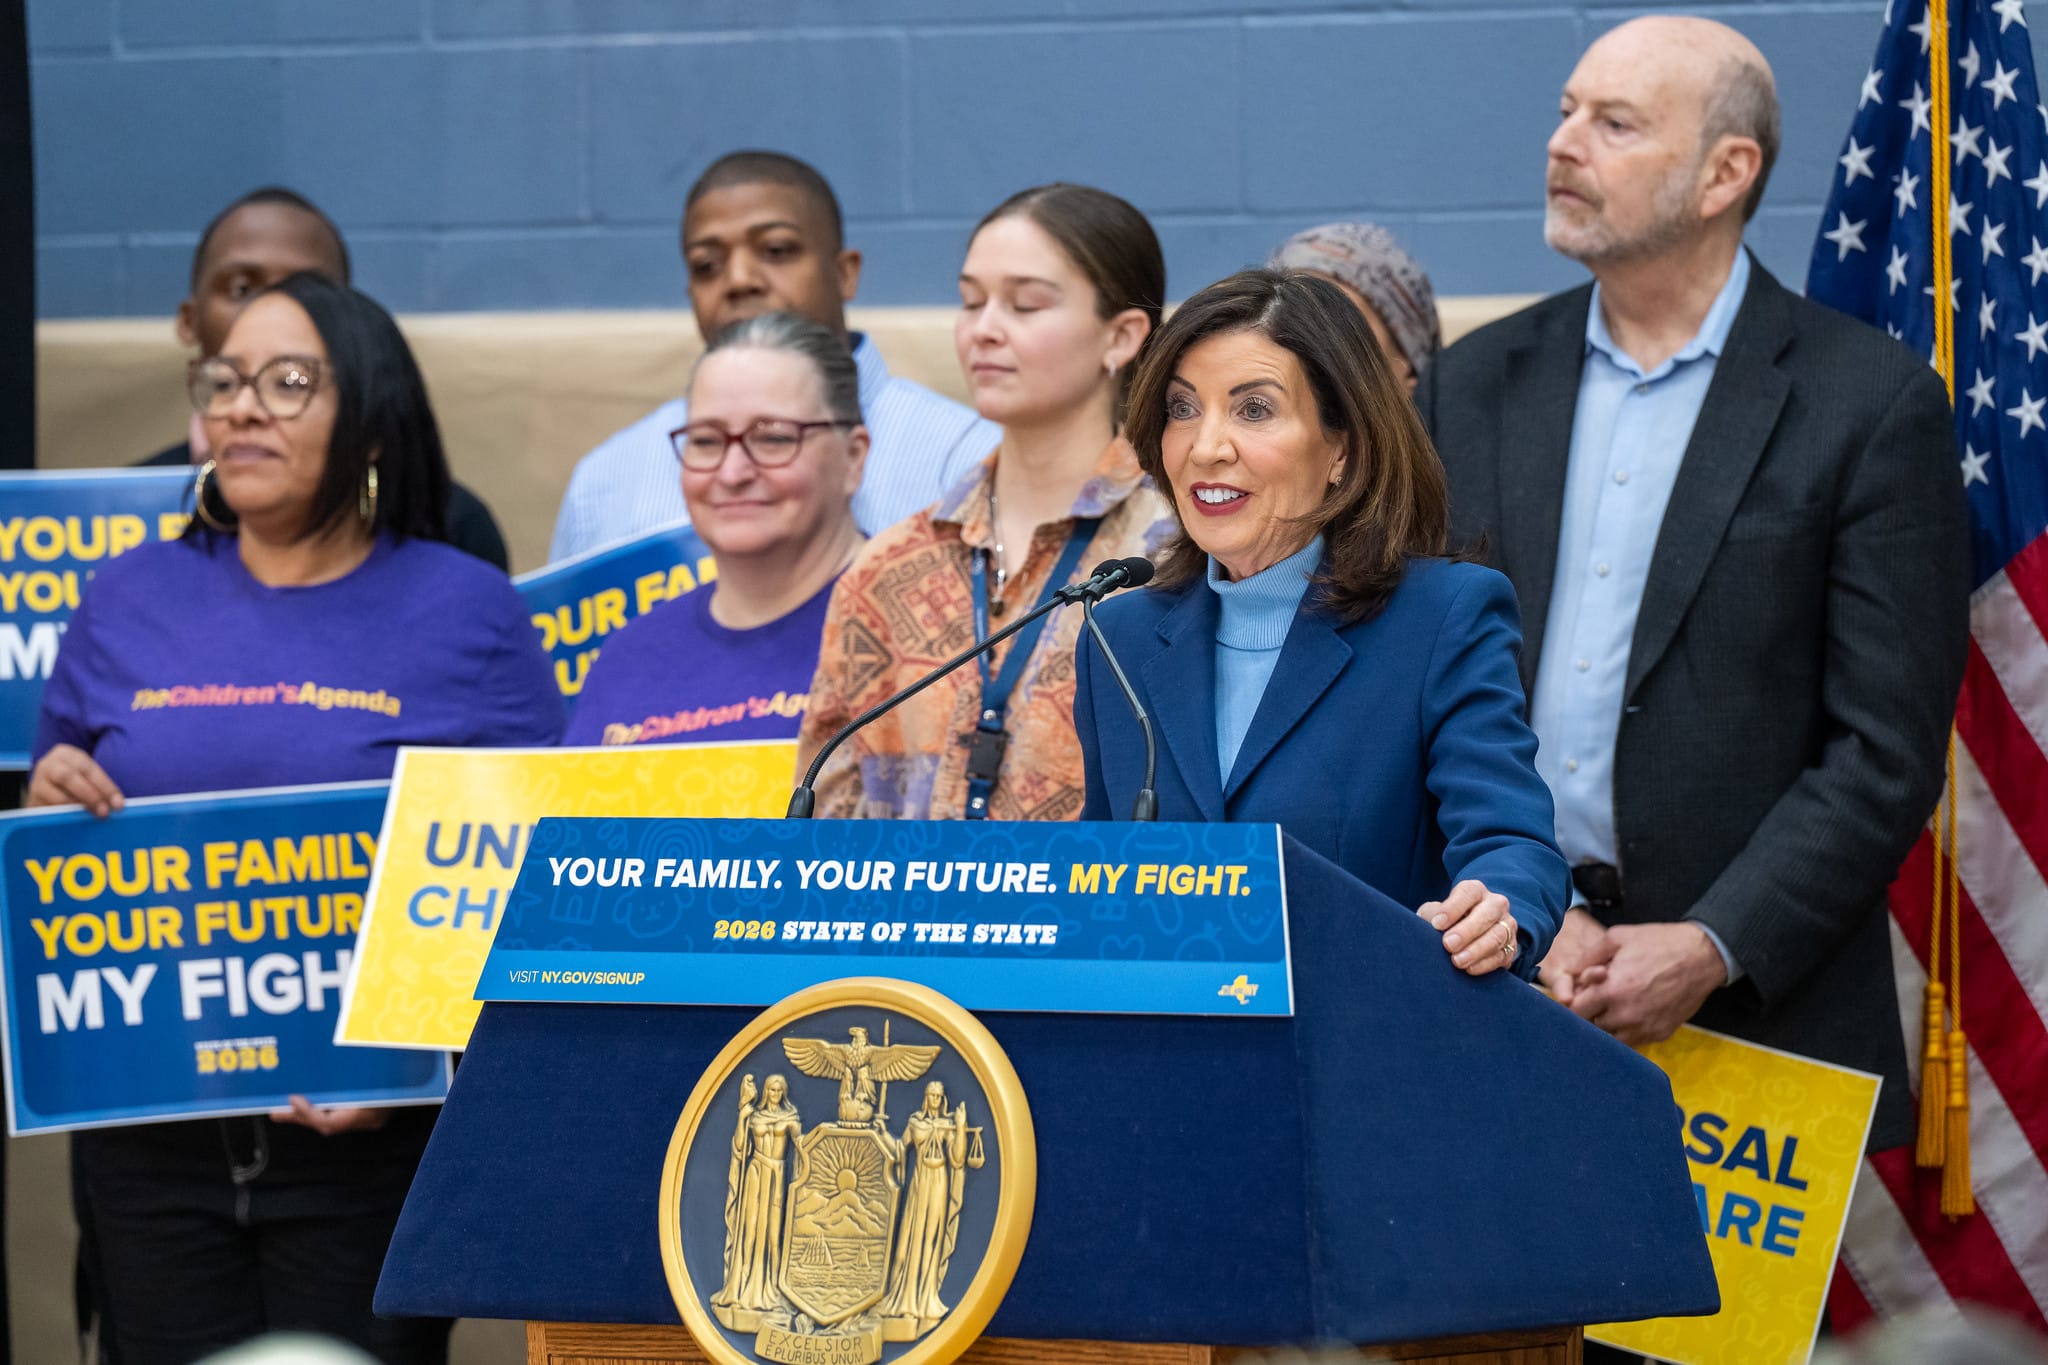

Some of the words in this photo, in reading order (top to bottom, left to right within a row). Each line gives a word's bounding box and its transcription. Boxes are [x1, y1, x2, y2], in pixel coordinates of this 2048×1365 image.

[425, 821, 538, 869] UN
[25, 846, 191, 904] YOUR
[548, 857, 646, 887] YOUR
[654, 858, 782, 889] FAMILY.
[795, 860, 896, 891] YOUR
[904, 861, 1057, 894] FUTURE.
[1068, 863, 1129, 894] MY
[1134, 864, 1251, 897] FIGHT.
[31, 907, 183, 960] YOUR
[195, 892, 369, 945] FUTUR
[407, 885, 513, 931] CH
[713, 919, 776, 941] 2026
[781, 920, 866, 942] STATE
[871, 921, 907, 943] OF
[913, 922, 968, 944] THE
[972, 923, 1058, 946] STATE
[36, 963, 158, 1035] MY
[178, 950, 355, 1022] FIGH
[509, 970, 540, 984] VISIT
[541, 971, 645, 986] NY.GOV/SIGNUP
[196, 1045, 279, 1074] 2026
[1676, 1104, 1809, 1192] SAL
[764, 1344, 772, 1357] E
[774, 1347, 827, 1364] PLURIBUS
[830, 1352, 864, 1363] UNUM
[769, 1329, 862, 1353] EXCELSIOR
